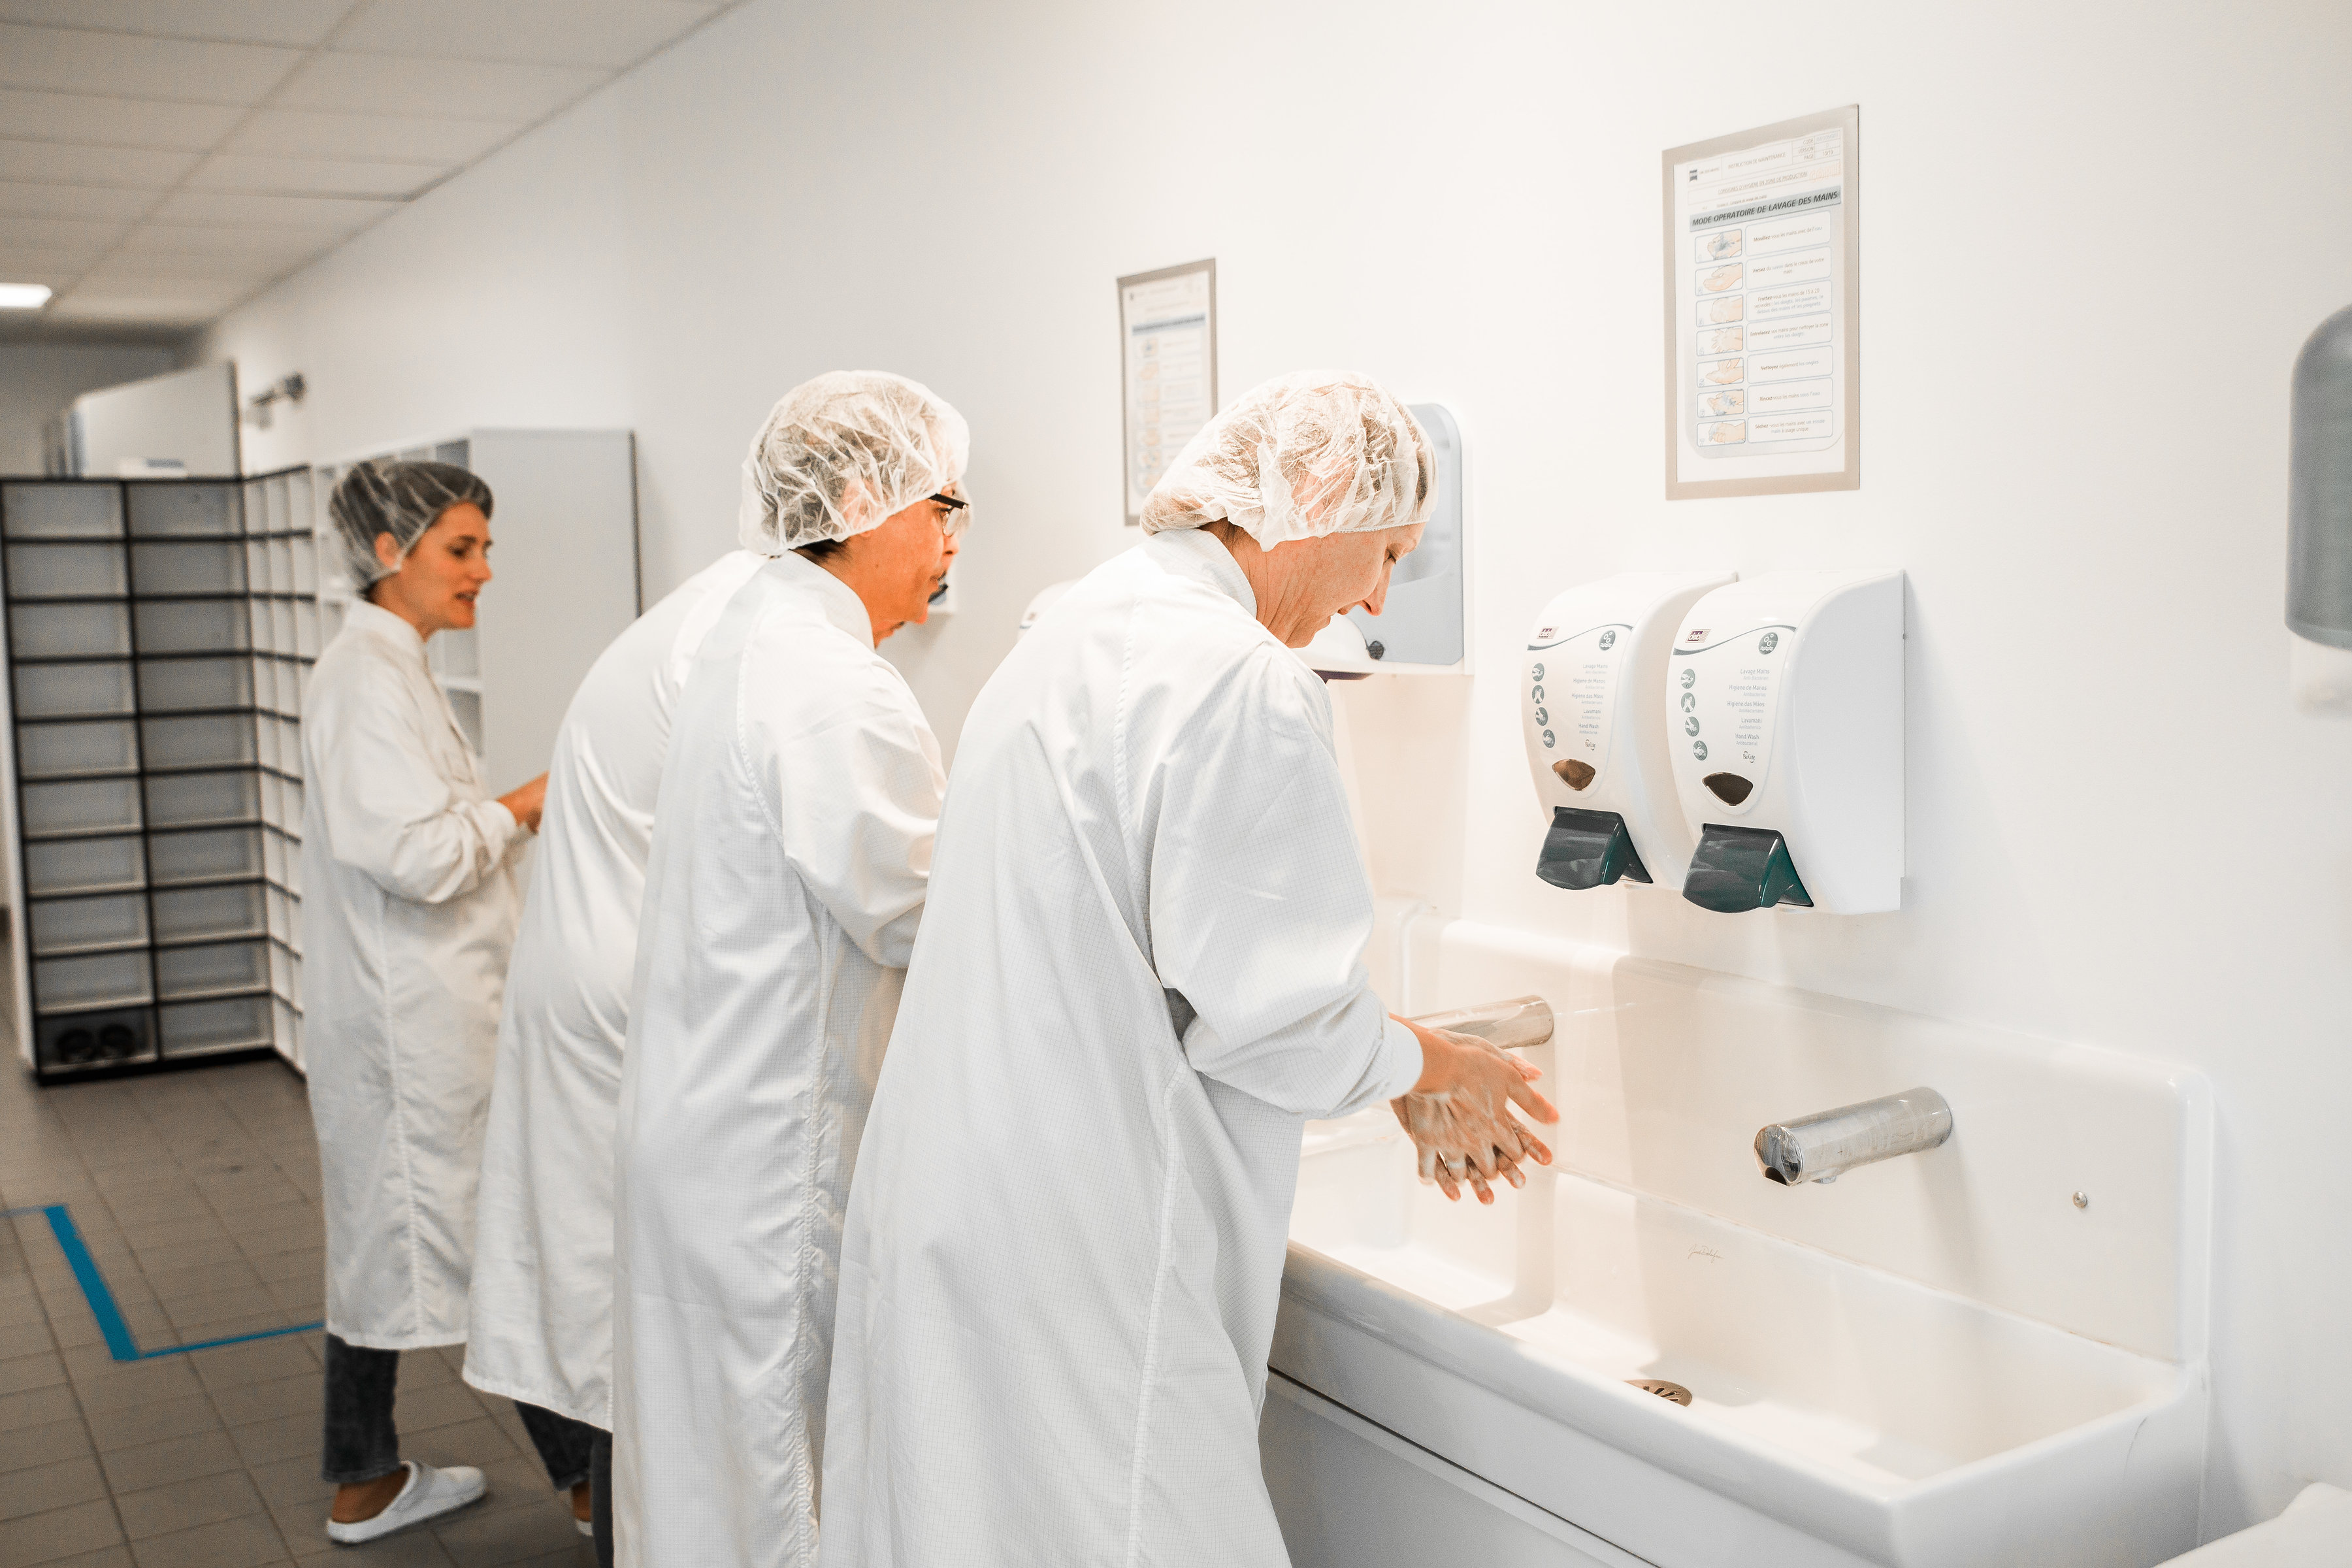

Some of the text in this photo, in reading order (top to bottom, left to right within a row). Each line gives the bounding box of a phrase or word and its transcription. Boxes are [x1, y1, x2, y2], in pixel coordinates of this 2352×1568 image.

[1727, 160, 1752, 170] INSTRUCTION
[1757, 152, 1786, 163] MAINTENANCE
[1718, 186, 1738, 195] CONSIGNES
[1782, 172, 1807, 182] PRODUCTION
[1692, 216, 1712, 227] MODE
[1714, 207, 1755, 222] OPERATOIRE
[1757, 204, 1767, 214] DE
[1768, 199, 1796, 211] LAVAGE
[1798, 197, 1812, 206] DES
[1813, 191, 1838, 204] MAINS
[1688, 632, 1701, 640] deb
